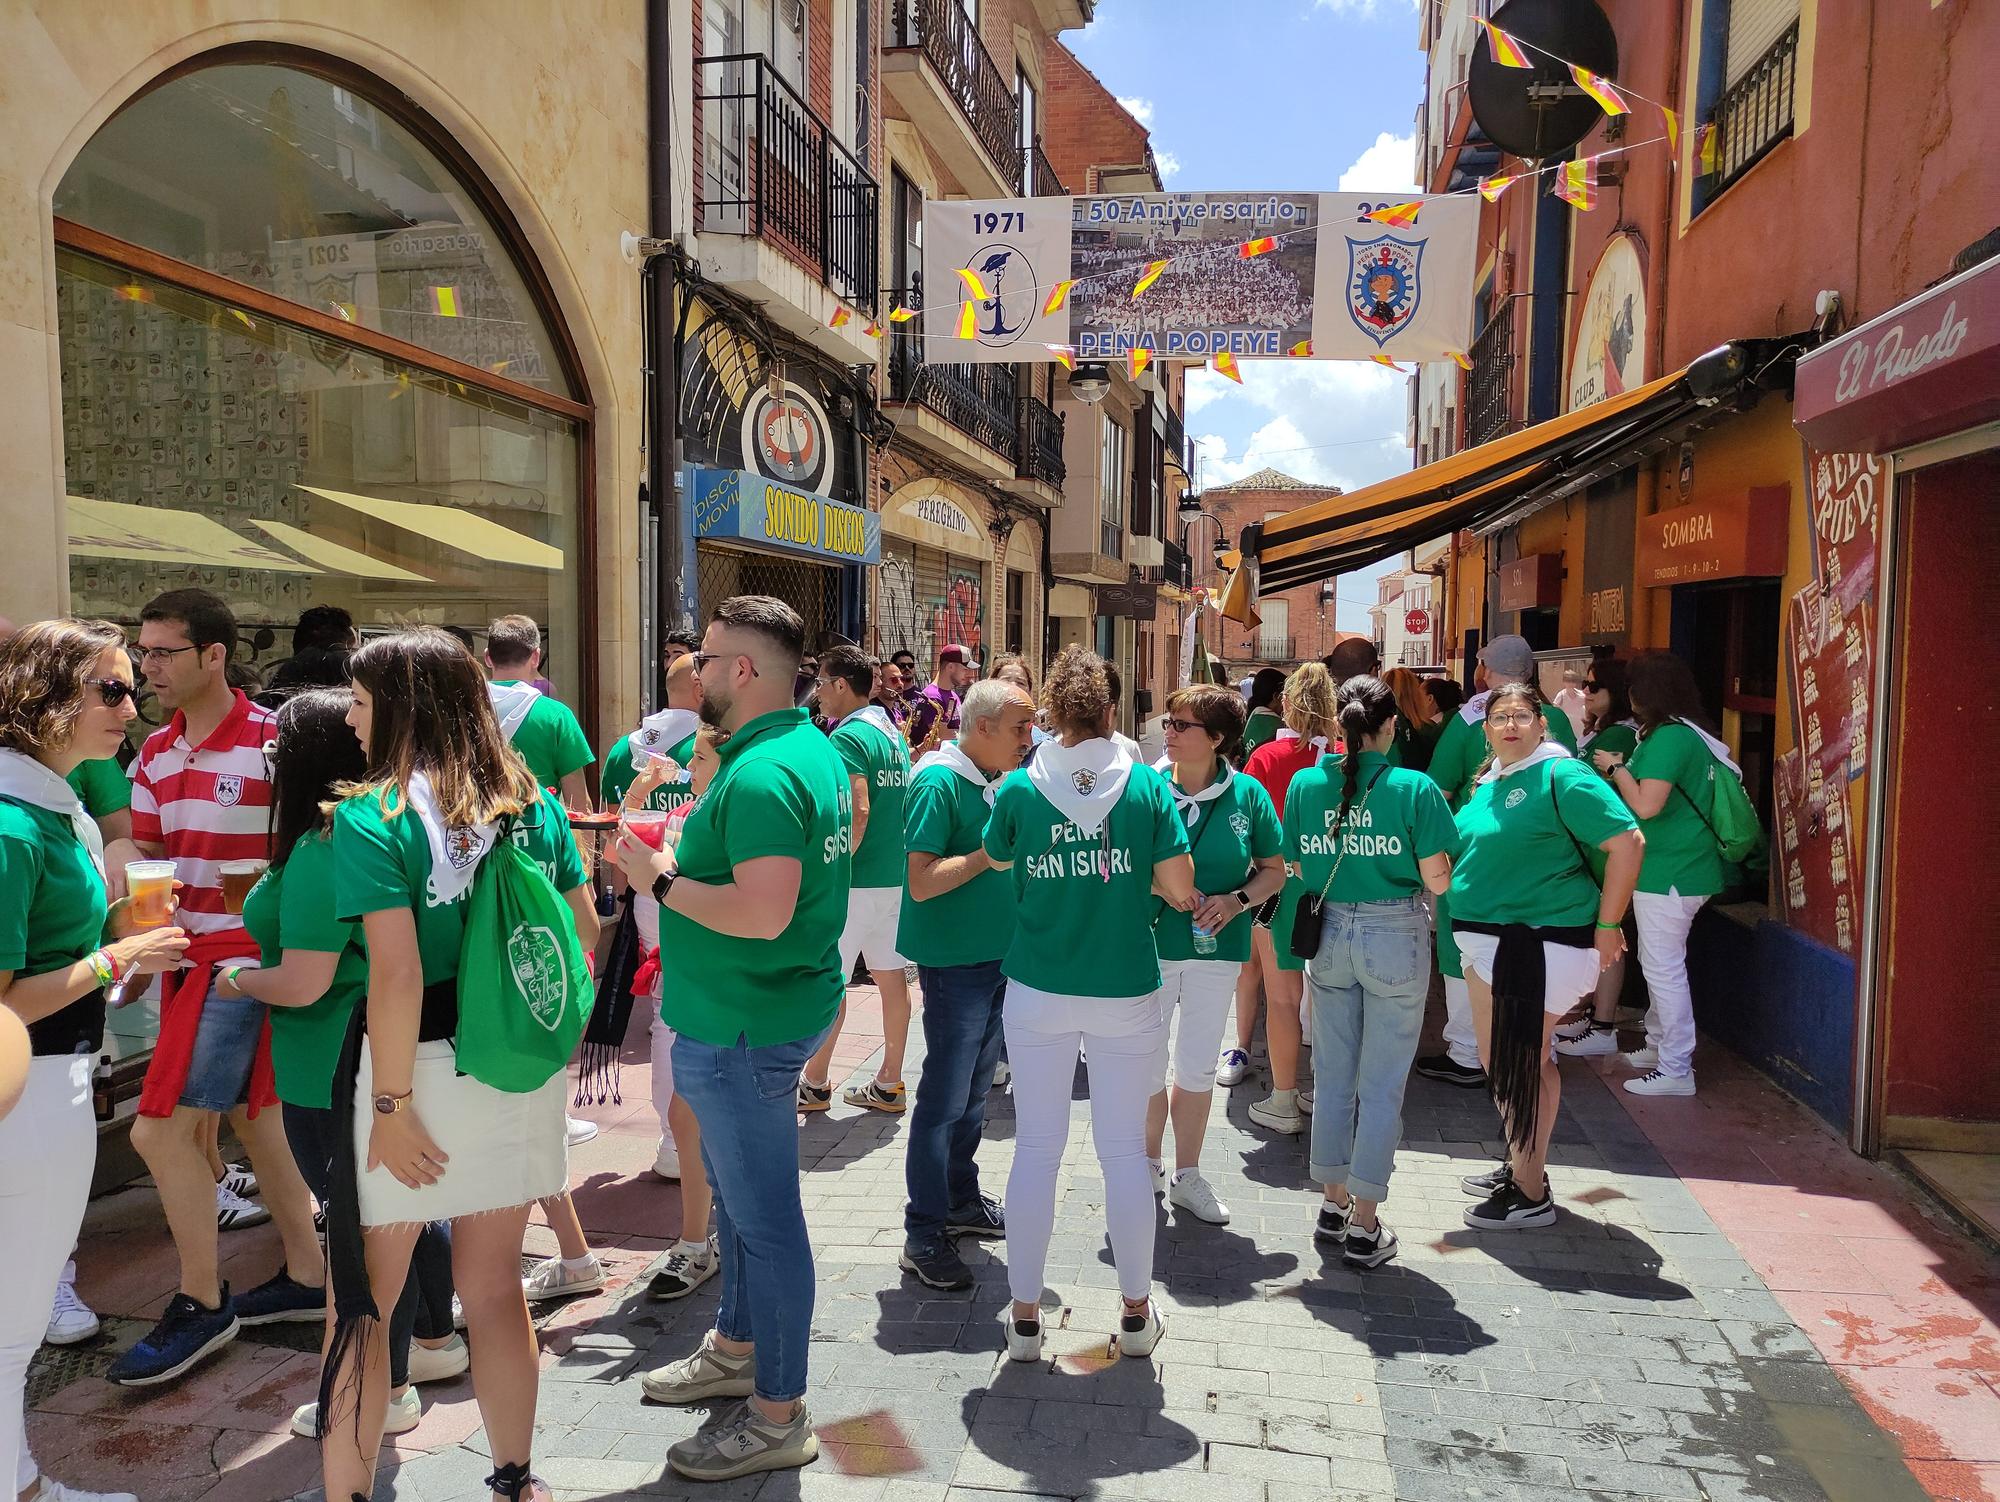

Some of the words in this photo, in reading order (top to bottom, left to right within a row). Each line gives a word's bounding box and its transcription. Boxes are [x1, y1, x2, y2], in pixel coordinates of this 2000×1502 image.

[973, 212, 1025, 234] 1971
[1089, 200, 1120, 221] 50
[1129, 199, 1296, 221] Aniversario
[1167, 331, 1281, 357] POPEYE
[1835, 340, 1870, 403] El
[1868, 300, 1968, 388] Ruedo
[1575, 376, 1594, 407] CLUB
[694, 468, 740, 519] DISCO
[765, 484, 819, 548] SONIDO
[824, 503, 865, 556] DISCOS
[917, 499, 967, 533] PEREGRINO
[1662, 512, 1714, 549] SOMBRA
[1406, 618, 1426, 626] STOP
[1300, 834, 1336, 855] SAN
[1343, 834, 1401, 856] ISIDRO
[1026, 852, 1065, 879] SAN
